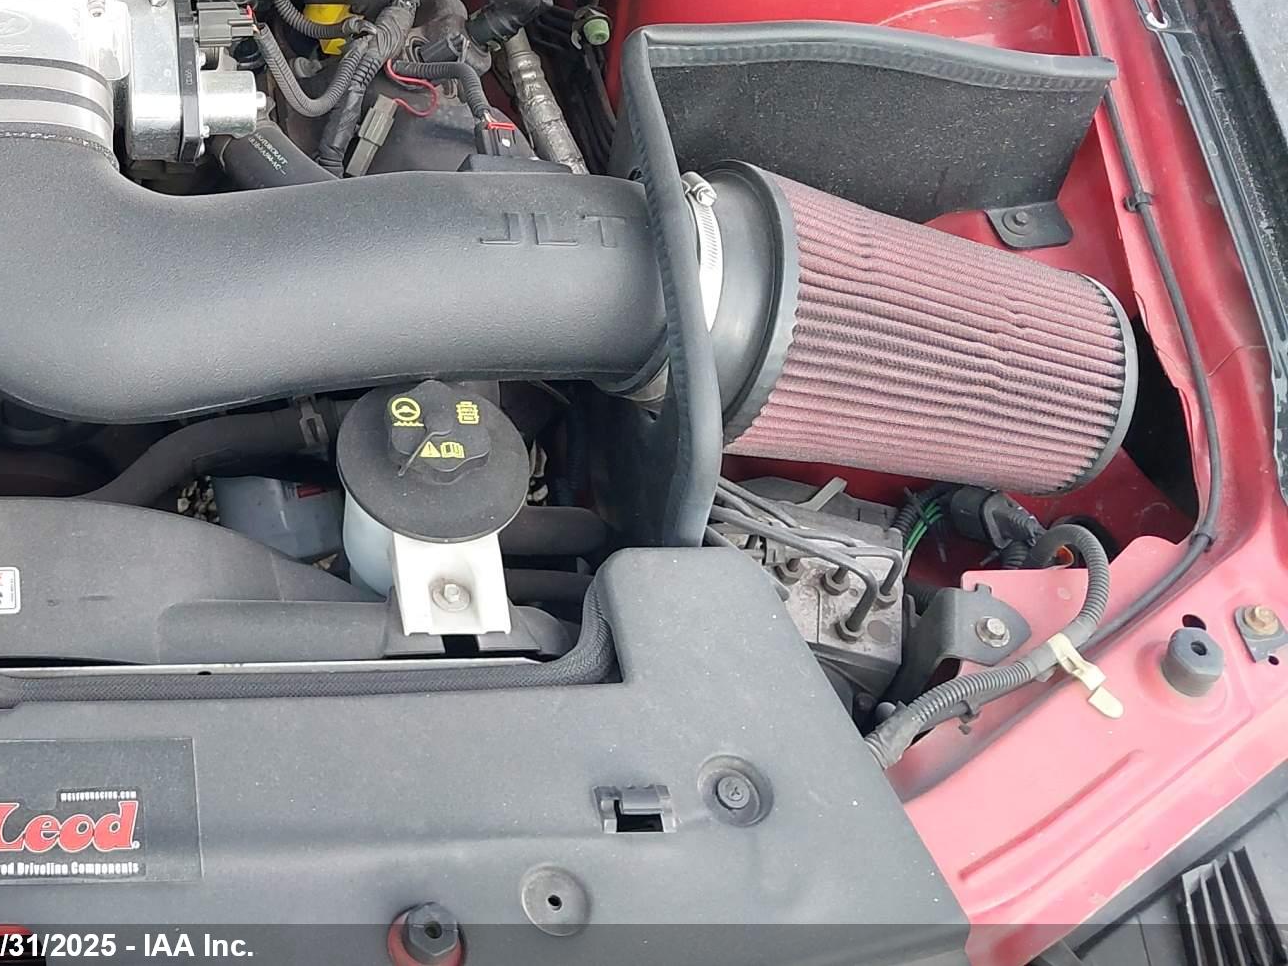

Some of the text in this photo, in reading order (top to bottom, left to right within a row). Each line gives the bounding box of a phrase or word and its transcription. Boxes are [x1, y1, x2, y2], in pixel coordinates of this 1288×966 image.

[479, 211, 628, 249] JLT
[16, 861, 69, 876] Driveline
[71, 861, 139, 876] Components
